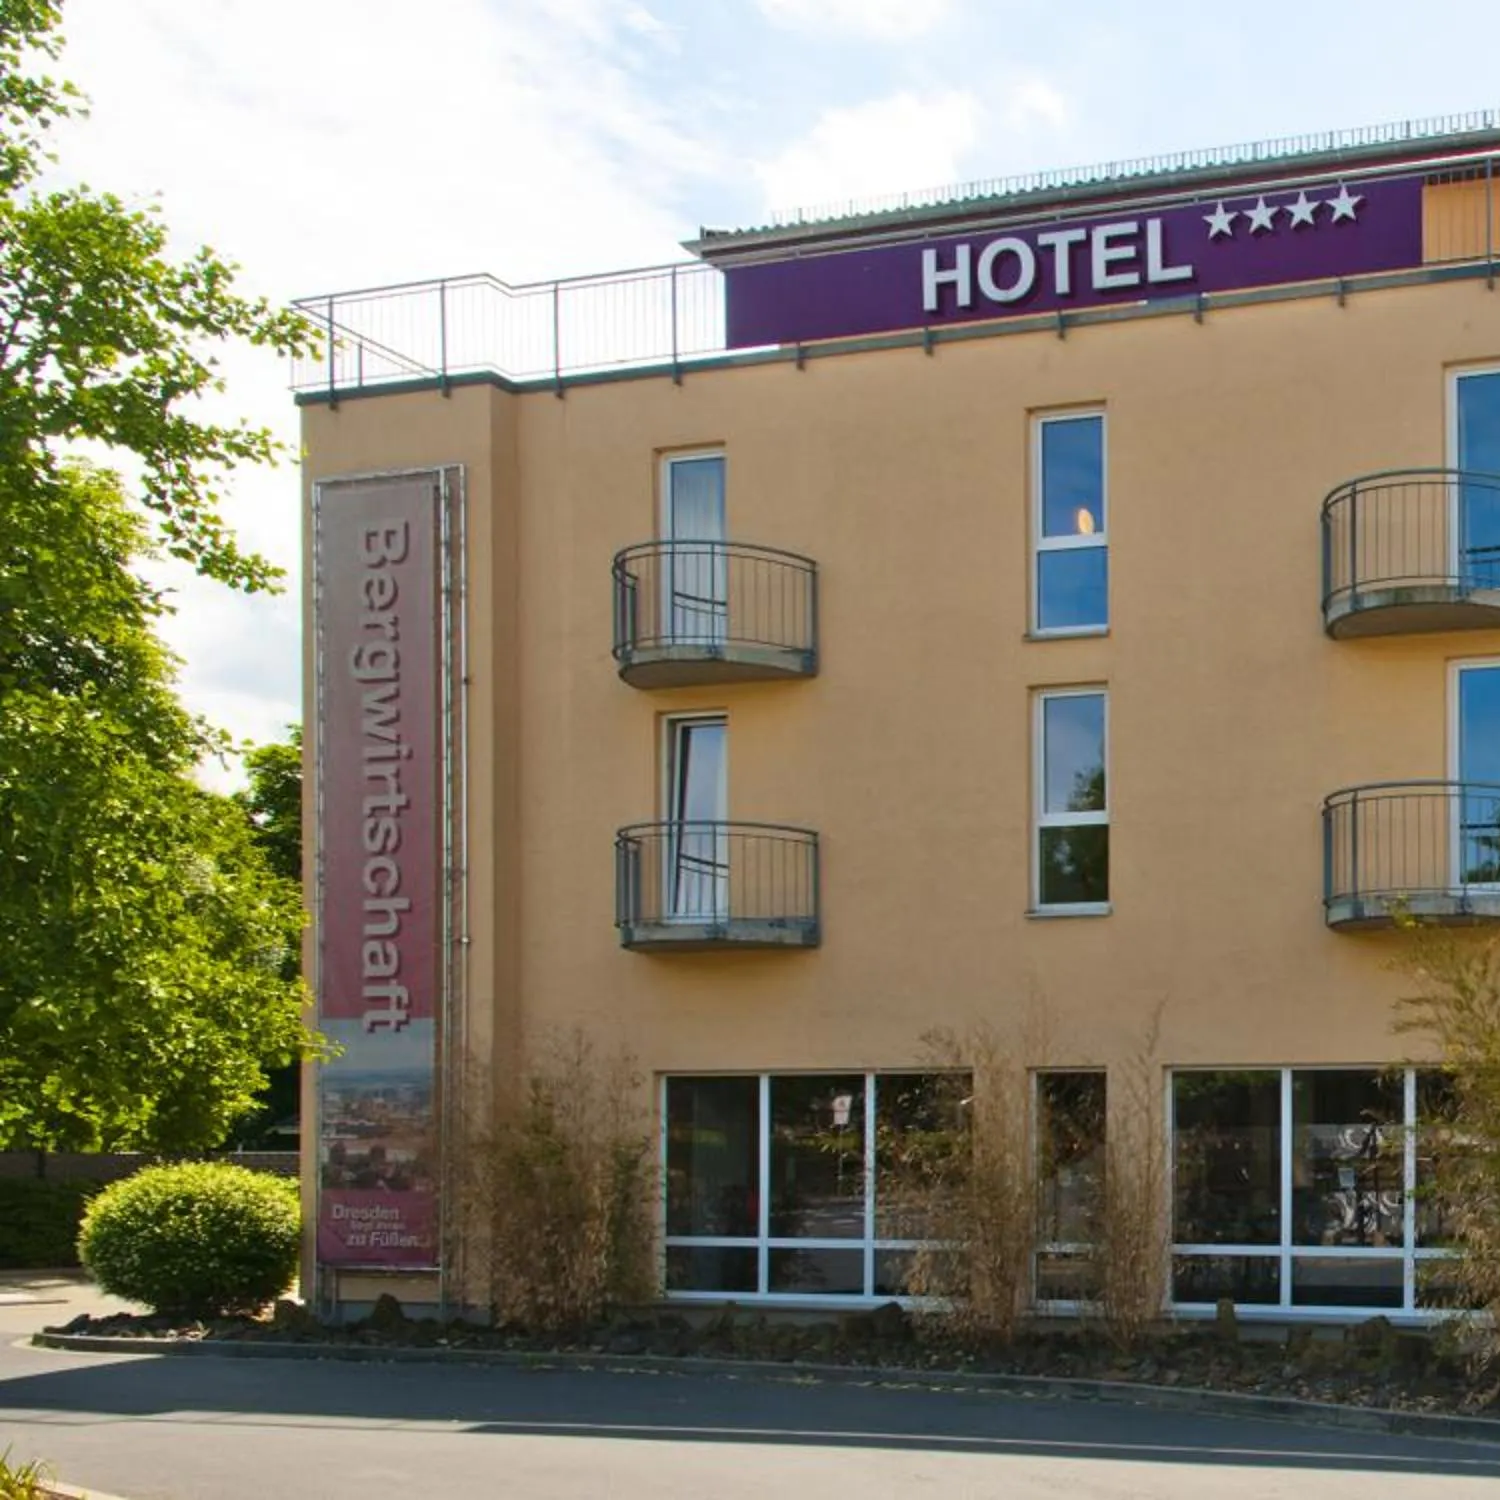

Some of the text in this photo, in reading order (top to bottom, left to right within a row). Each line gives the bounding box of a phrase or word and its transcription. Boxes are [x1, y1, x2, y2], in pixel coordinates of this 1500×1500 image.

[922, 218, 1192, 311] HOTEL
[350, 518, 410, 1031] Bergwirtschaft
[332, 1204, 400, 1220] Dresden
